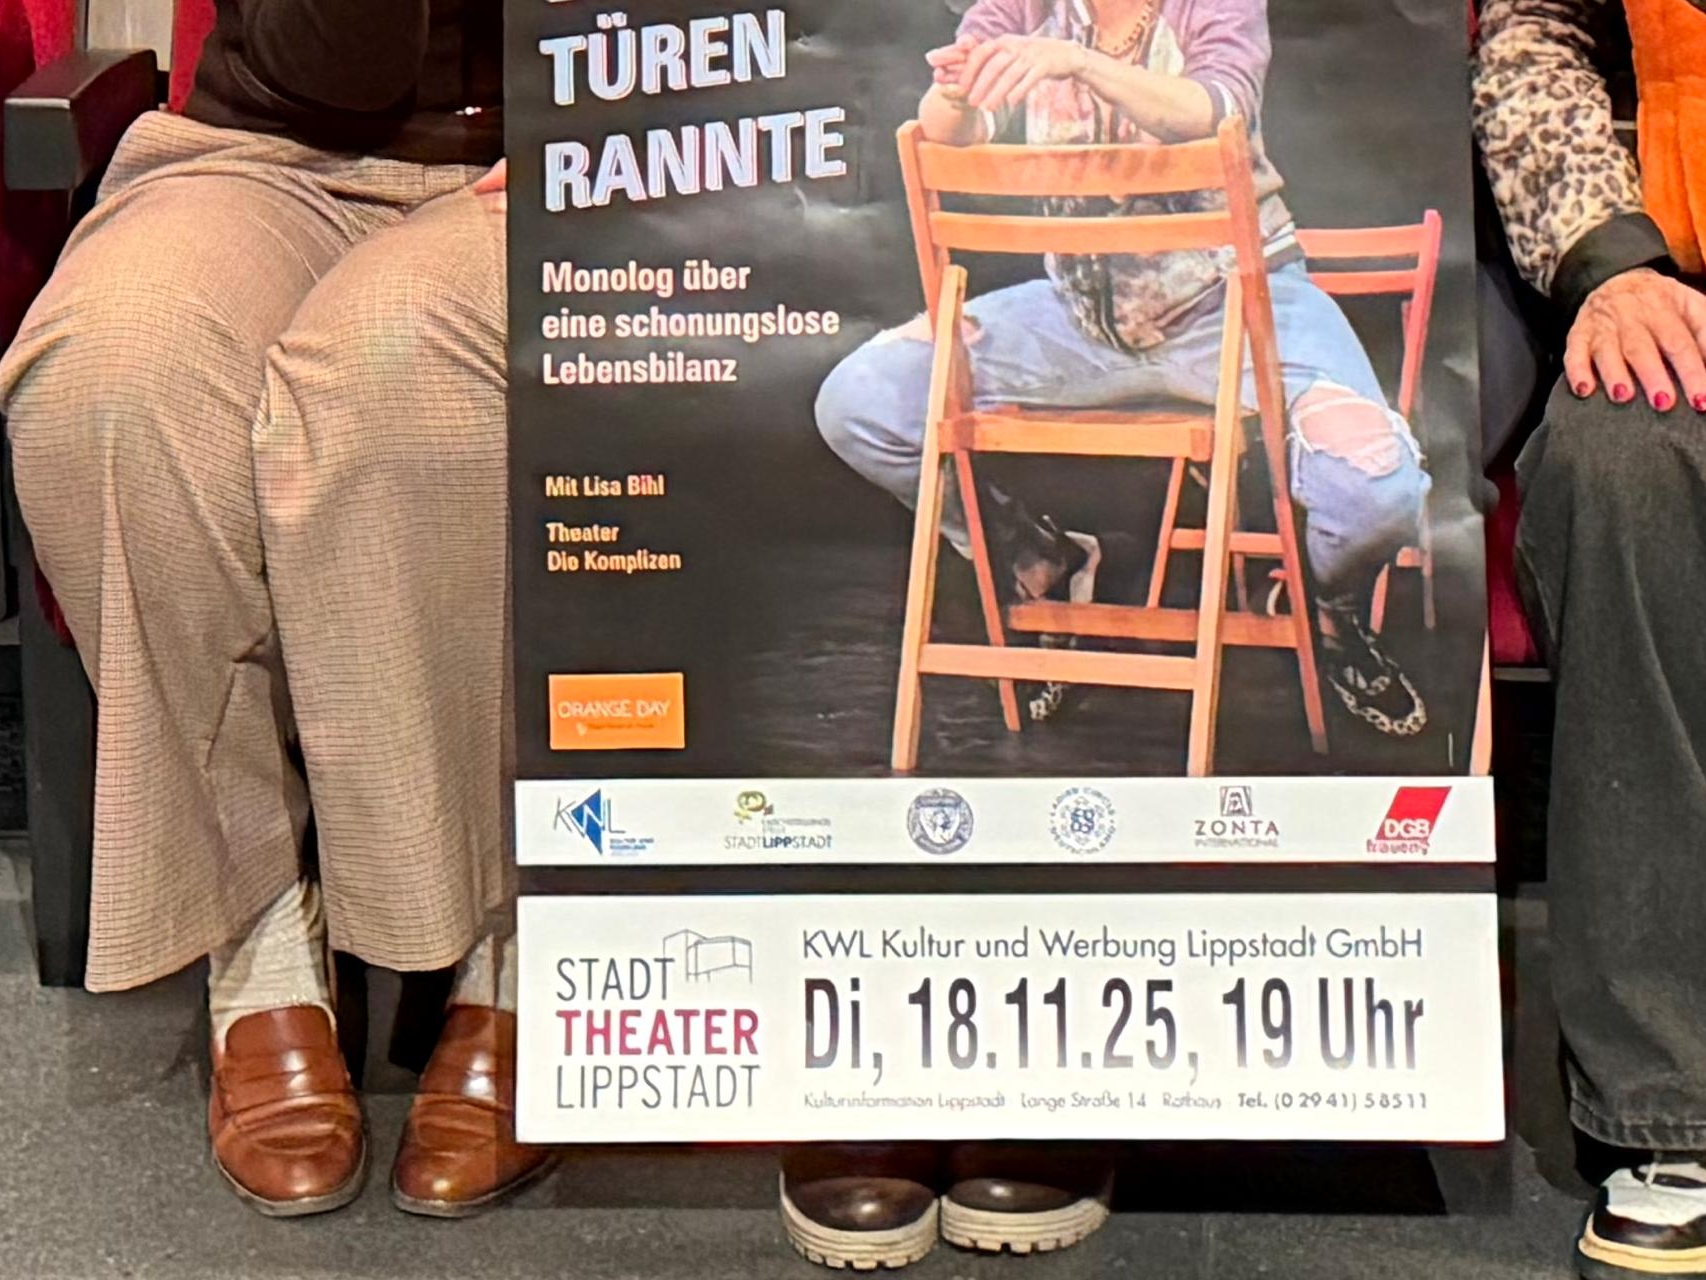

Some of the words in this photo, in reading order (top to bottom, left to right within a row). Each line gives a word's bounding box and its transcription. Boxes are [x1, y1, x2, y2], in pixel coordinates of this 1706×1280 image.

[538, 8, 786, 106] TÜREN
[544, 106, 847, 212] RANNTE
[541, 260, 674, 298] Monolog
[682, 259, 751, 291] über
[541, 306, 606, 339] eine
[614, 303, 841, 343] schonungslose
[542, 350, 738, 385] Lebensbilanz
[545, 475, 579, 497] Mit
[583, 475, 622, 497] Lisa
[627, 474, 665, 496] Bihl
[545, 522, 620, 542] Theater
[583, 548, 682, 574] Komplizen
[557, 699, 633, 719] ORANGE
[636, 699, 671, 717] DAY
[1194, 819, 1280, 836] ZONTA
[1384, 818, 1430, 839] DGB
[802, 928, 873, 959] KWL
[881, 925, 966, 959] Kultur
[975, 925, 1030, 959] und
[1038, 925, 1177, 968] Werbung
[1187, 924, 1317, 968] Lippstadt
[1325, 924, 1423, 958] GmbH
[556, 957, 675, 1001] STADT
[555, 1008, 759, 1056] THEATER
[804, 977, 884, 1087] Di,
[907, 976, 1200, 1087] 18.11.25,
[1222, 976, 1293, 1070] 19
[1317, 976, 1425, 1071] Uhr
[556, 1064, 761, 1110] LIPPSTADT
[1237, 1091, 1269, 1109] Tel.
